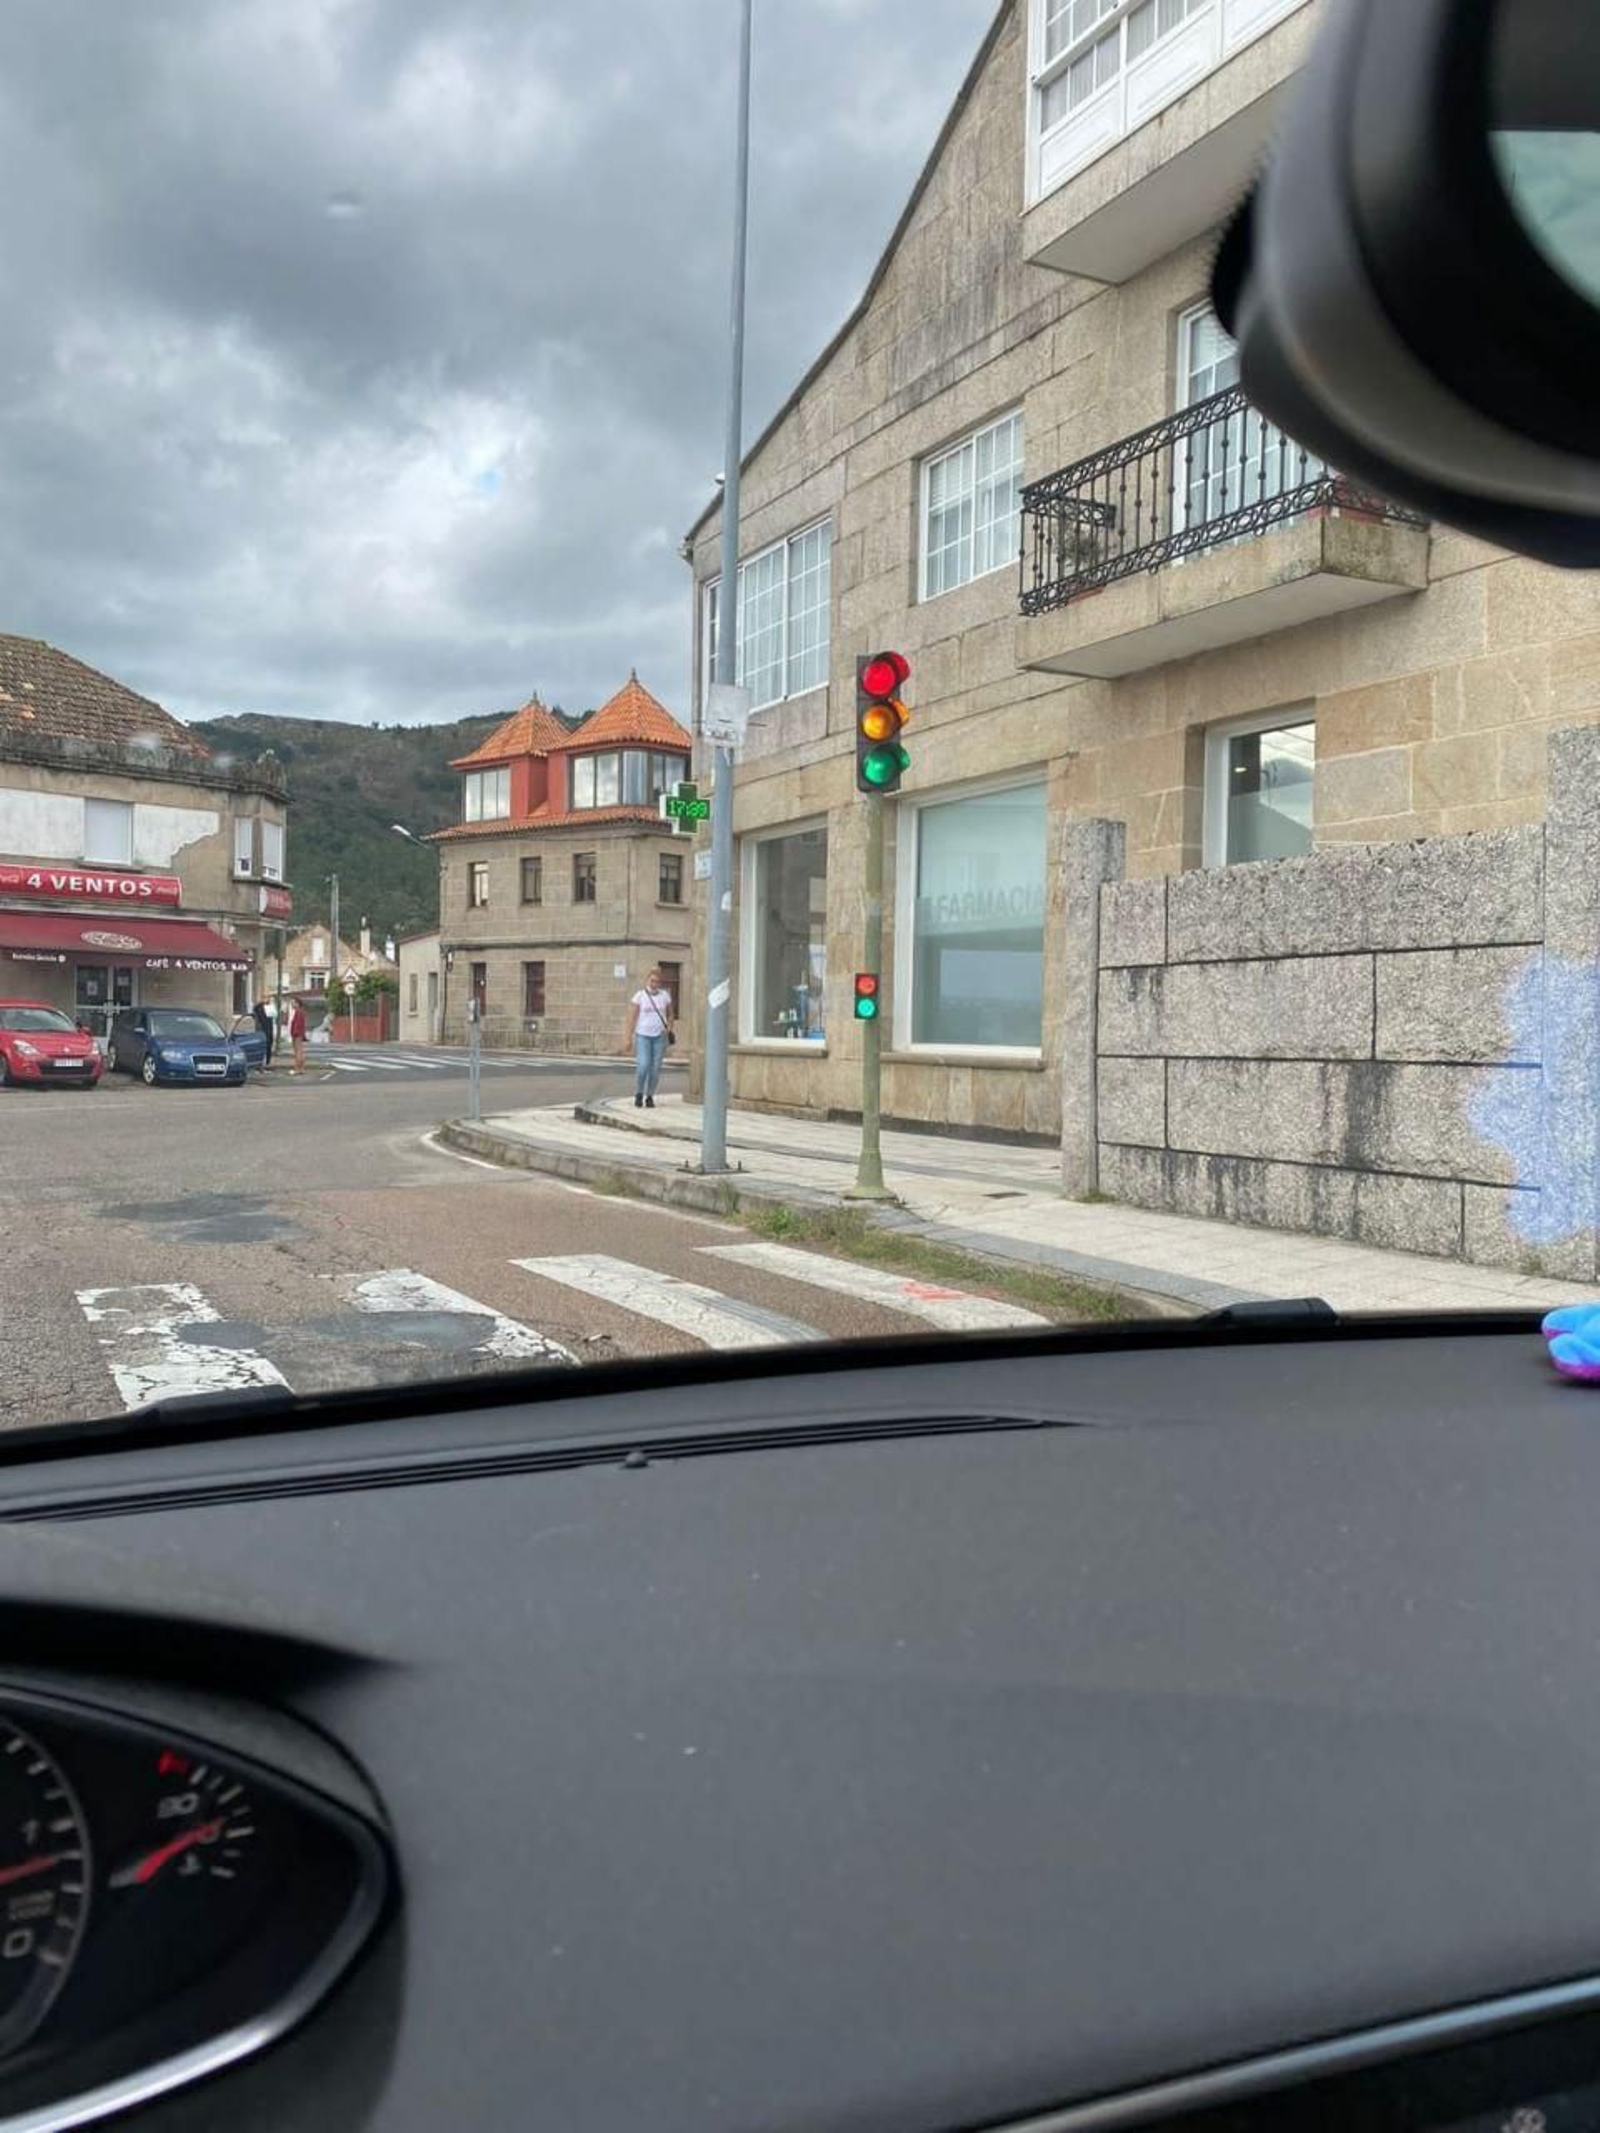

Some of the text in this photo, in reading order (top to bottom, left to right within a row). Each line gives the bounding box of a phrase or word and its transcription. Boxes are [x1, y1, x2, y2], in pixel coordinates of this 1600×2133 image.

[27, 873, 42, 889] 4
[51, 875, 152, 896] VENTOS
[184, 960, 227, 970] VENTOS
